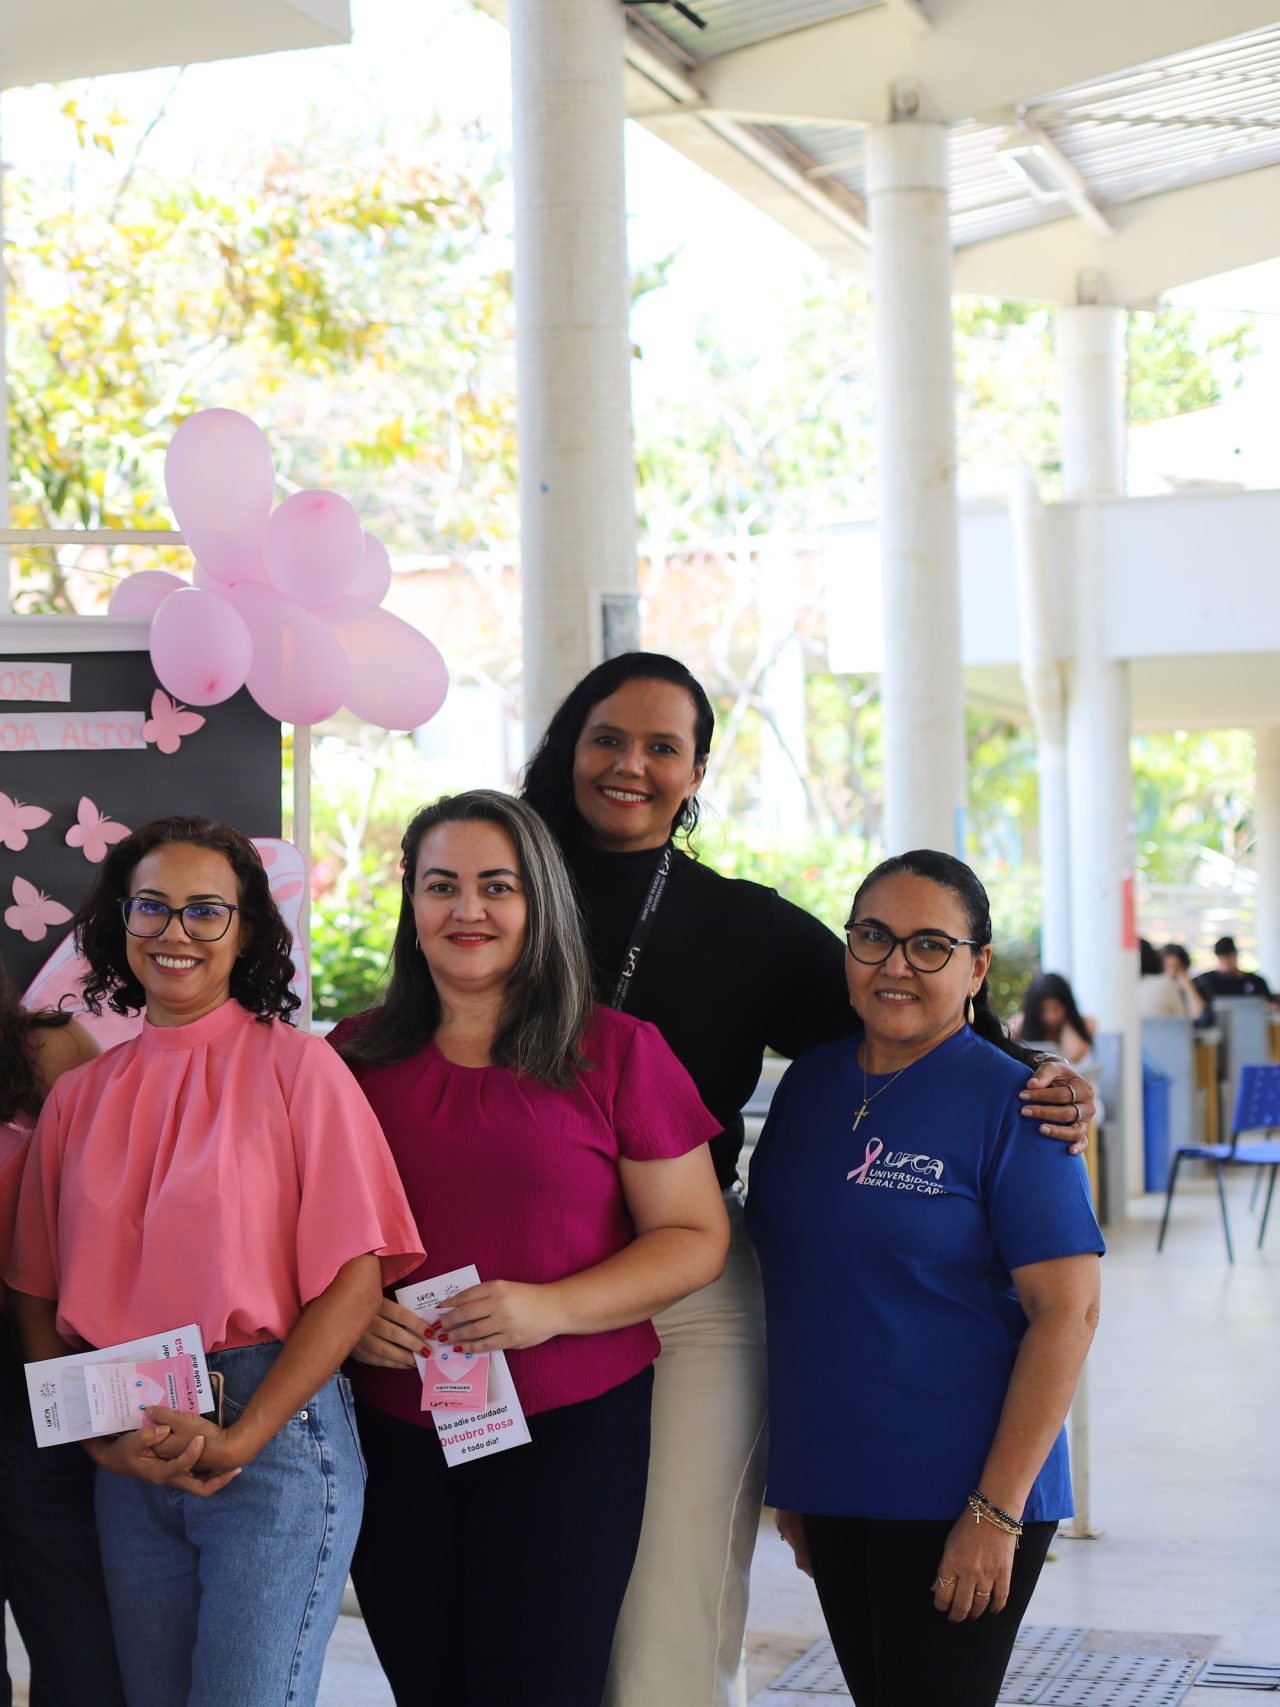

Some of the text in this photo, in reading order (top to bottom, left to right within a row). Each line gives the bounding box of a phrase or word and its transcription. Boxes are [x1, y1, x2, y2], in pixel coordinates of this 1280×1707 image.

[62, 720, 136, 749] ALTO
[883, 1151, 944, 1180] UFCA
[896, 1182, 915, 1190] DO
[194, 1369, 202, 1388] todo
[438, 1422, 453, 1432] Não
[453, 1417, 470, 1428] adie
[476, 1405, 508, 1420] cuidado!
[439, 1418, 514, 1447] Outubro Rosa
[467, 1442, 485, 1452] todo
[485, 1437, 499, 1447] dia!
